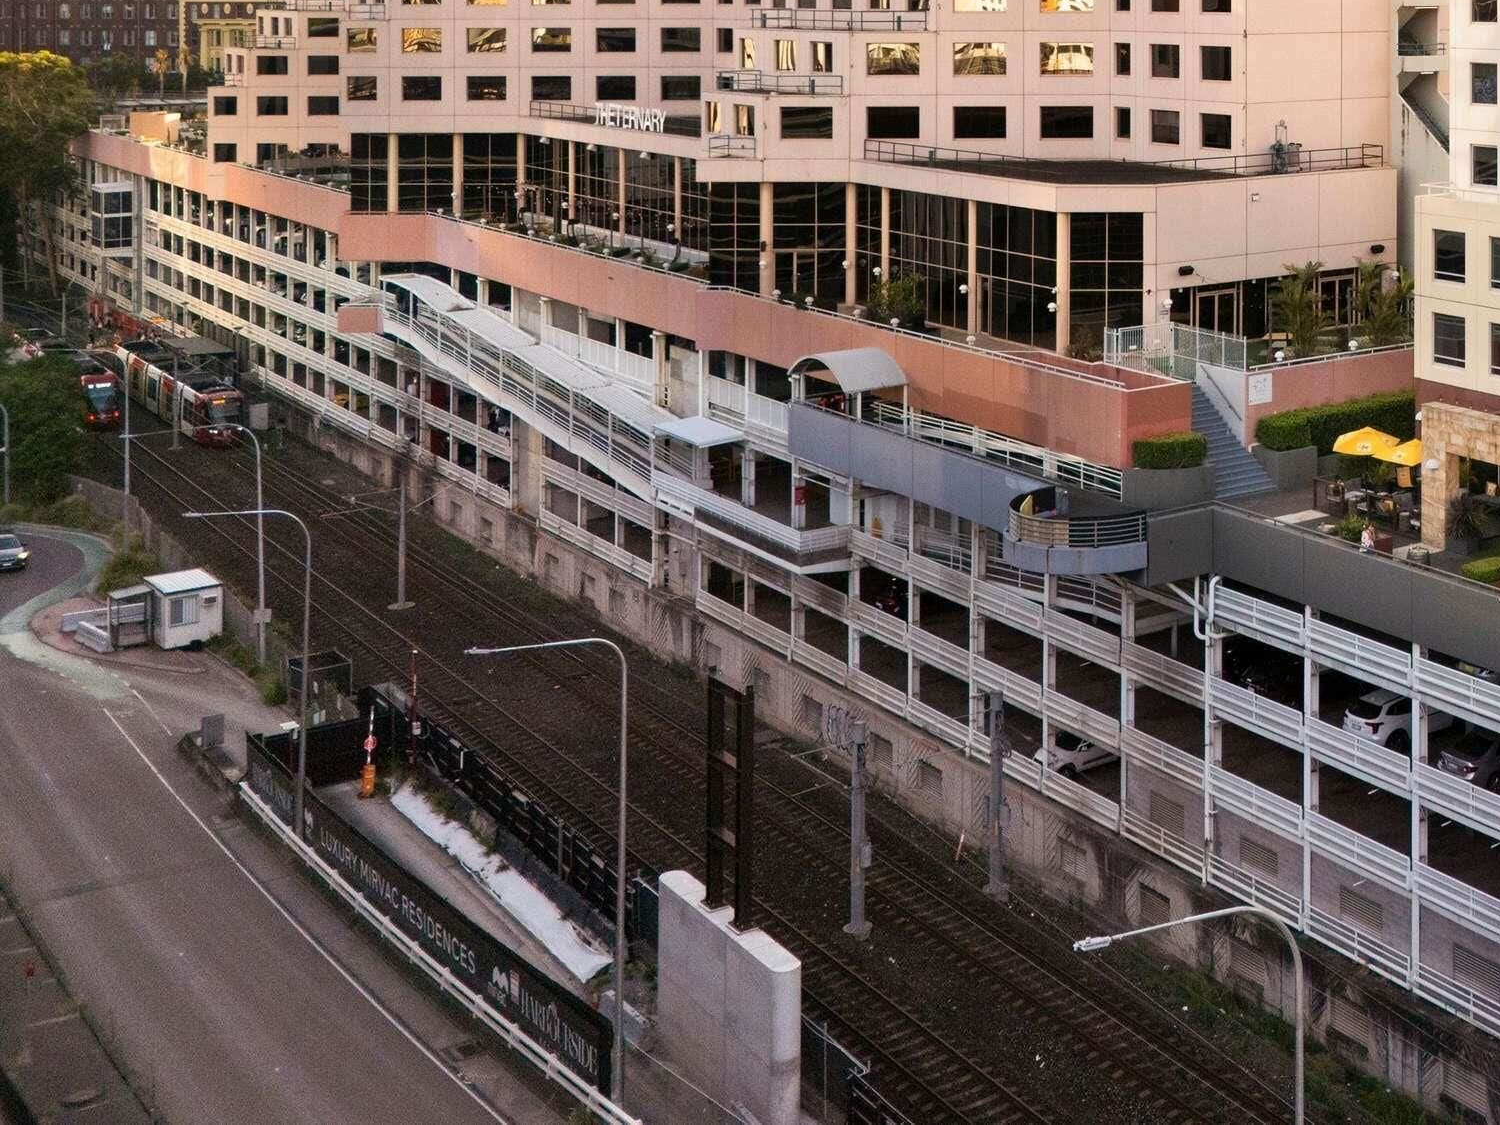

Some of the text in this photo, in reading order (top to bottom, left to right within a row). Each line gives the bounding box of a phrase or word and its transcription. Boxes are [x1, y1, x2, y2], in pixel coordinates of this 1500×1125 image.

[320, 827, 476, 975] LUXURY MIRVAC RESIDENCES
